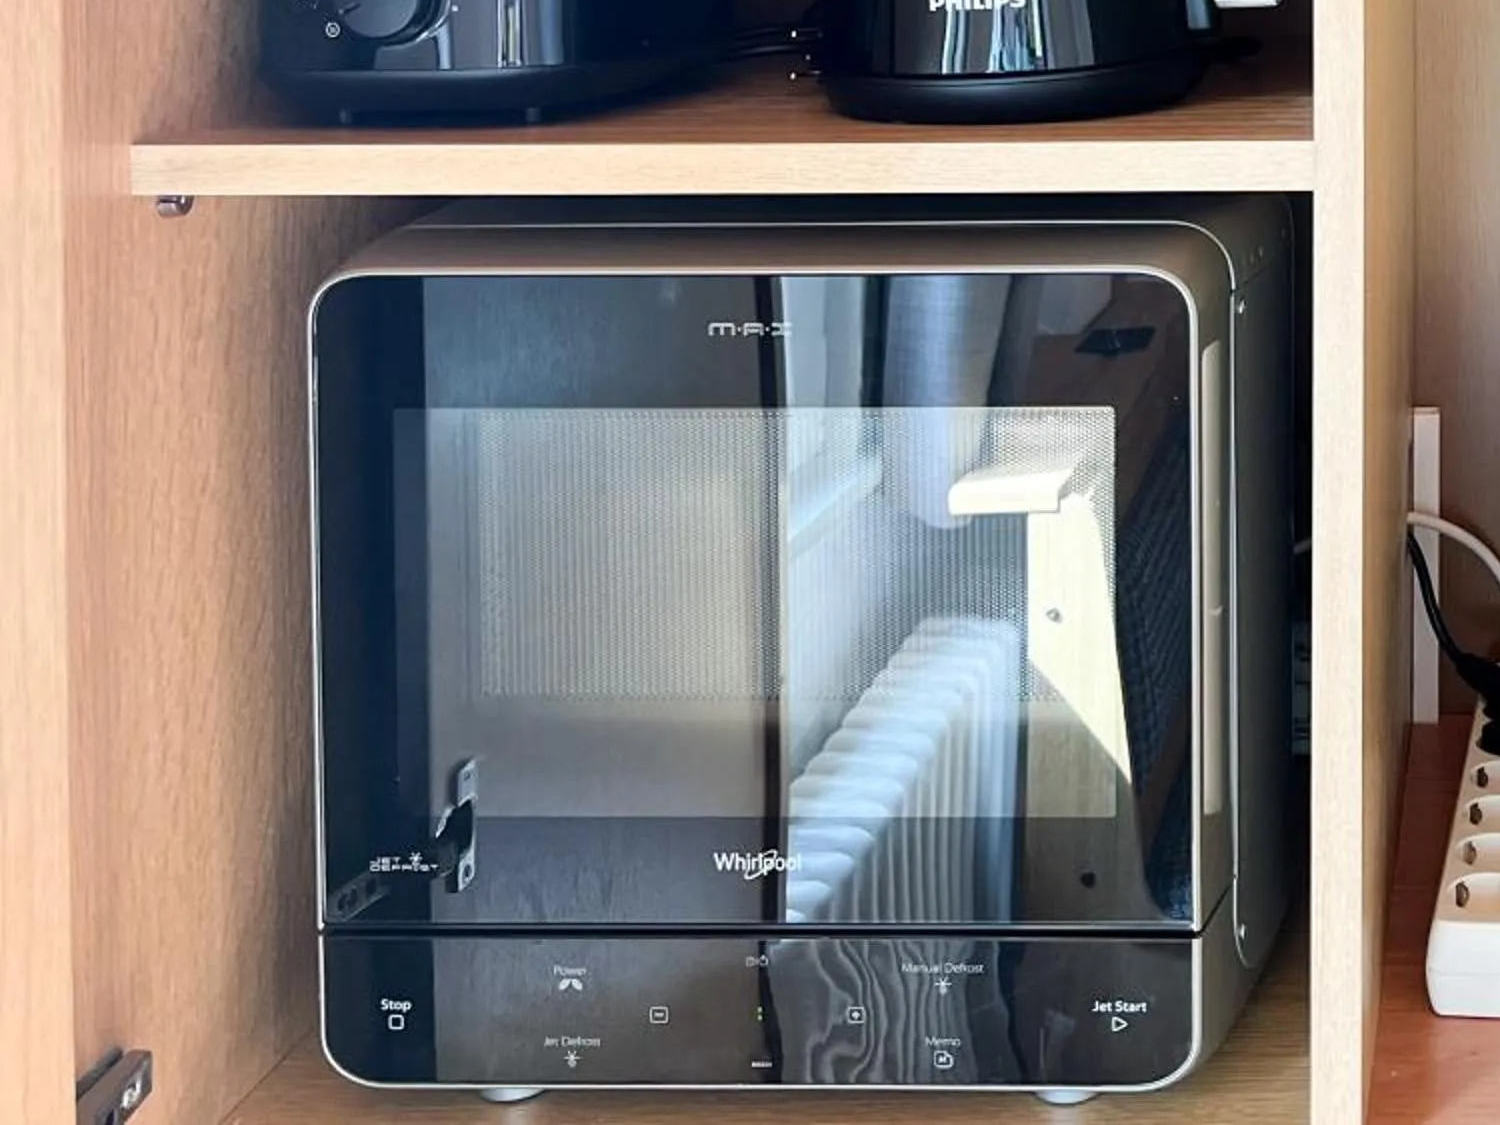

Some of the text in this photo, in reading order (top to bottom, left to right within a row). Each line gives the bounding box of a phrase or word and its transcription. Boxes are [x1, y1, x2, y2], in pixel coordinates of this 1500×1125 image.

[713, 850, 802, 879] Whirlpool
[381, 998, 412, 1013] Stop
[1092, 1000, 1147, 1013] Jet Start
